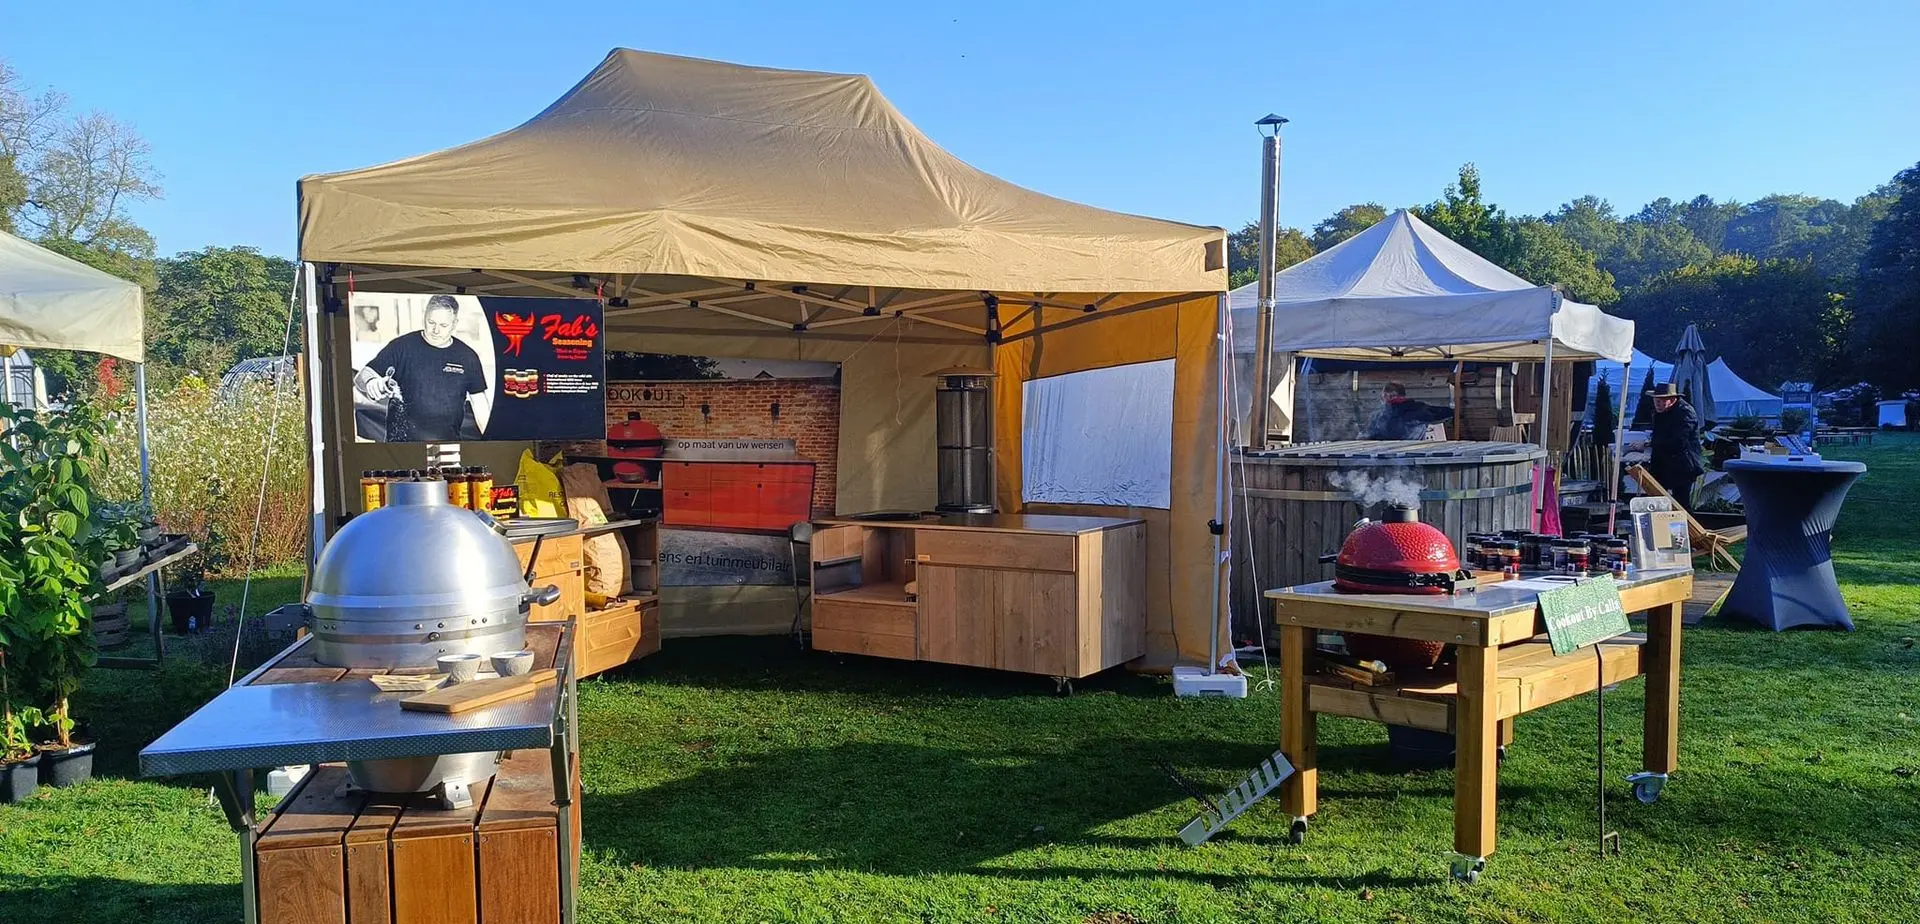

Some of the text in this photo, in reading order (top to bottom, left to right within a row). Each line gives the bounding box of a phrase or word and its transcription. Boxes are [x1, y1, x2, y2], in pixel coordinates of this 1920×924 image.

[541, 314, 599, 339] Fab's
[552, 337, 593, 348] Seasoning
[678, 441, 690, 450] op
[693, 441, 715, 449] maat
[718, 441, 734, 449] van
[736, 441, 749, 449] uw
[685, 553, 701, 565] en
[1549, 611, 1586, 631] Cookout
[1585, 605, 1598, 620] By
